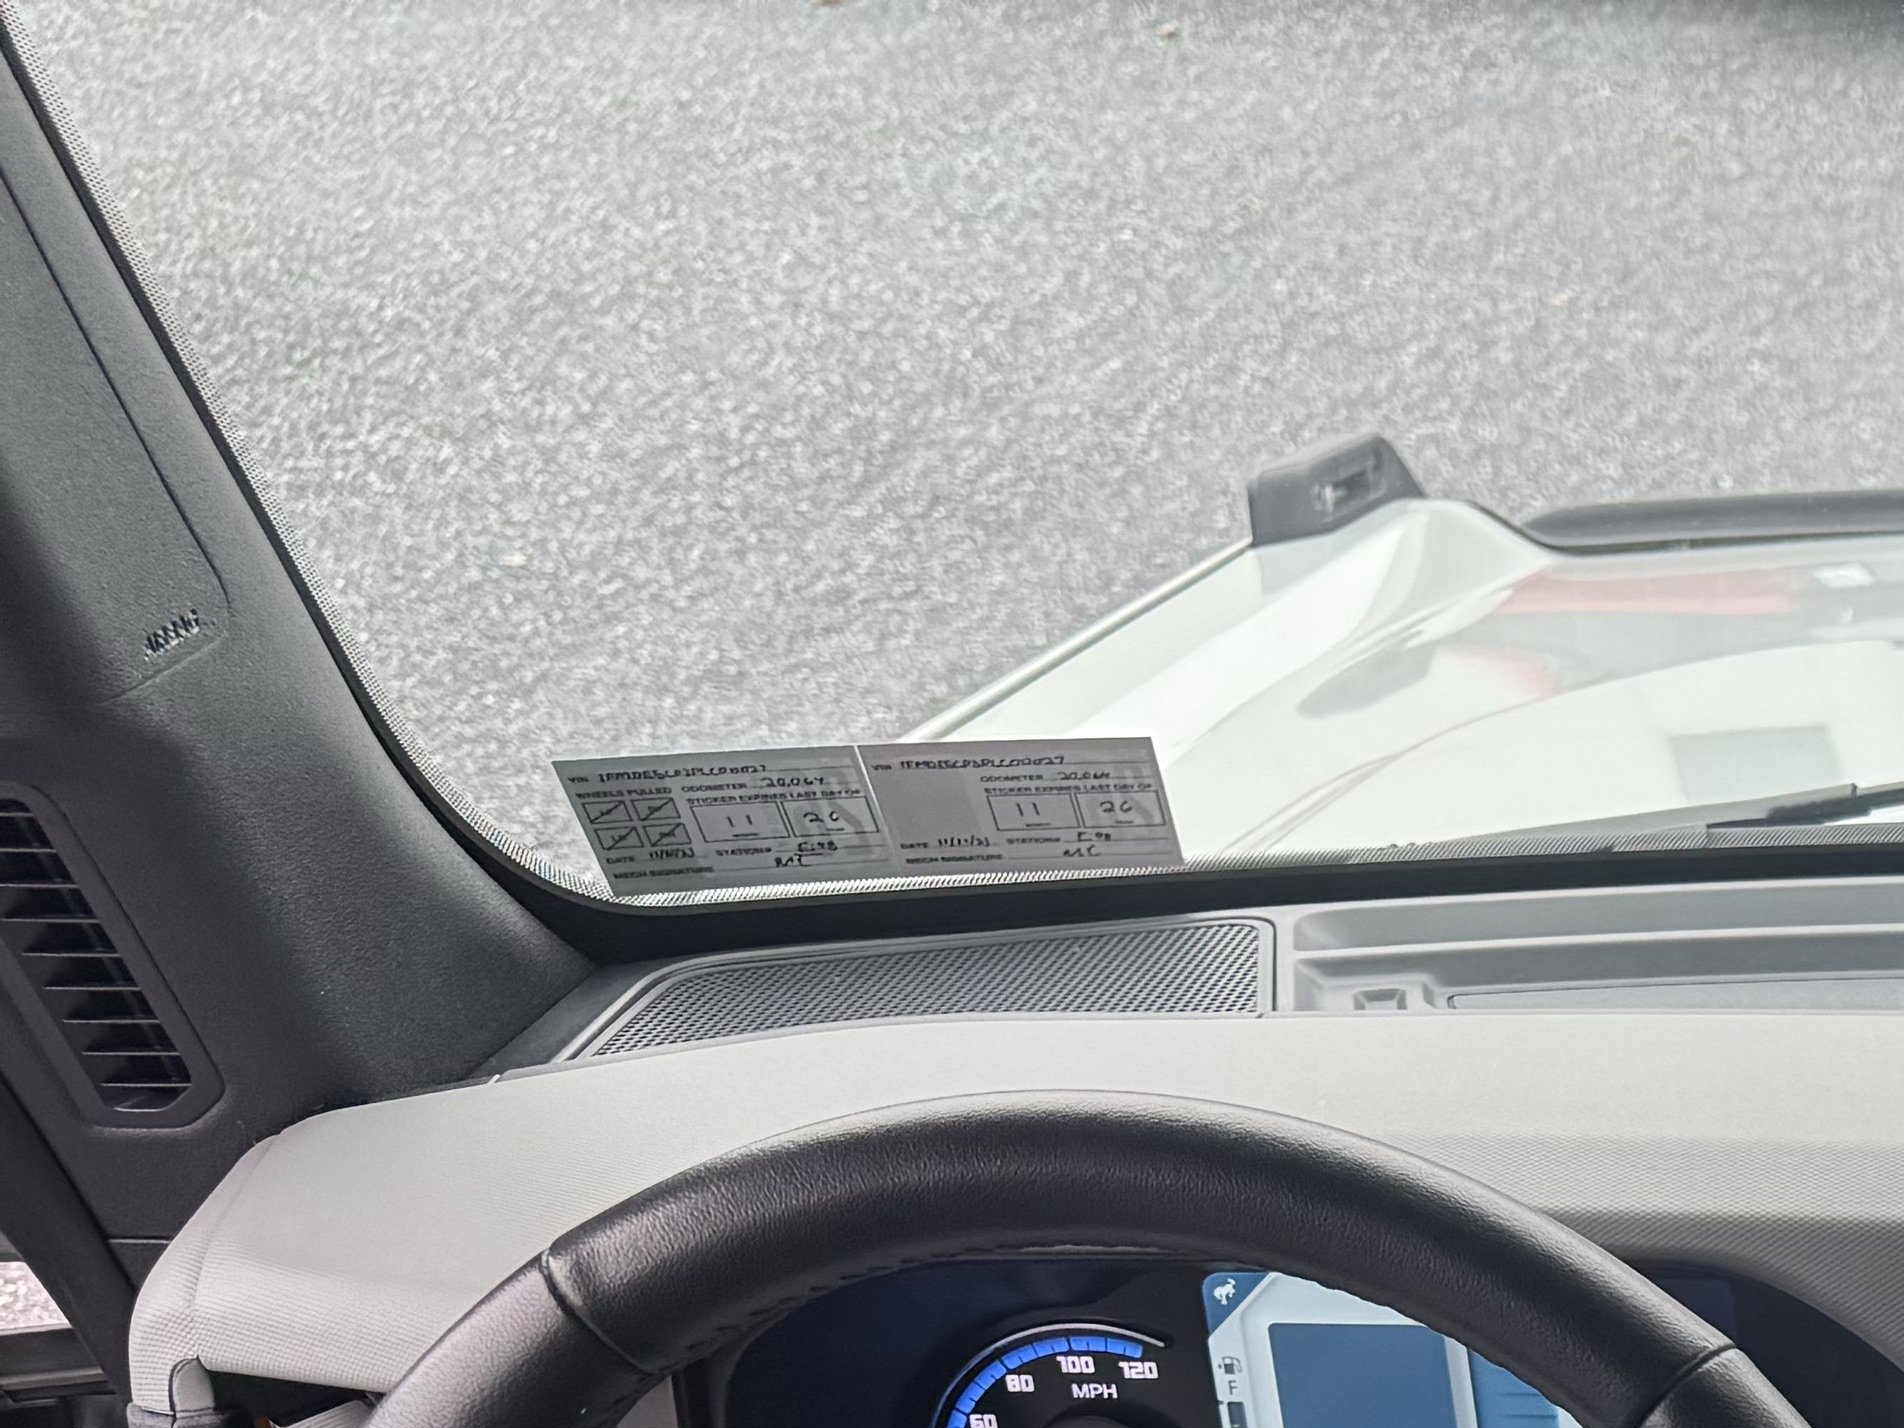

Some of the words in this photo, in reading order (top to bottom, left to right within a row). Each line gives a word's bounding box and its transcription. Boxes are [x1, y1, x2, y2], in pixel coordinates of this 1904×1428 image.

[1056, 1356, 1095, 1374] 100
[1118, 1361, 1159, 1380] 120
[1006, 1374, 1035, 1392] 80
[1071, 1383, 1118, 1399] MPH
[1229, 1381, 1239, 1395] F
